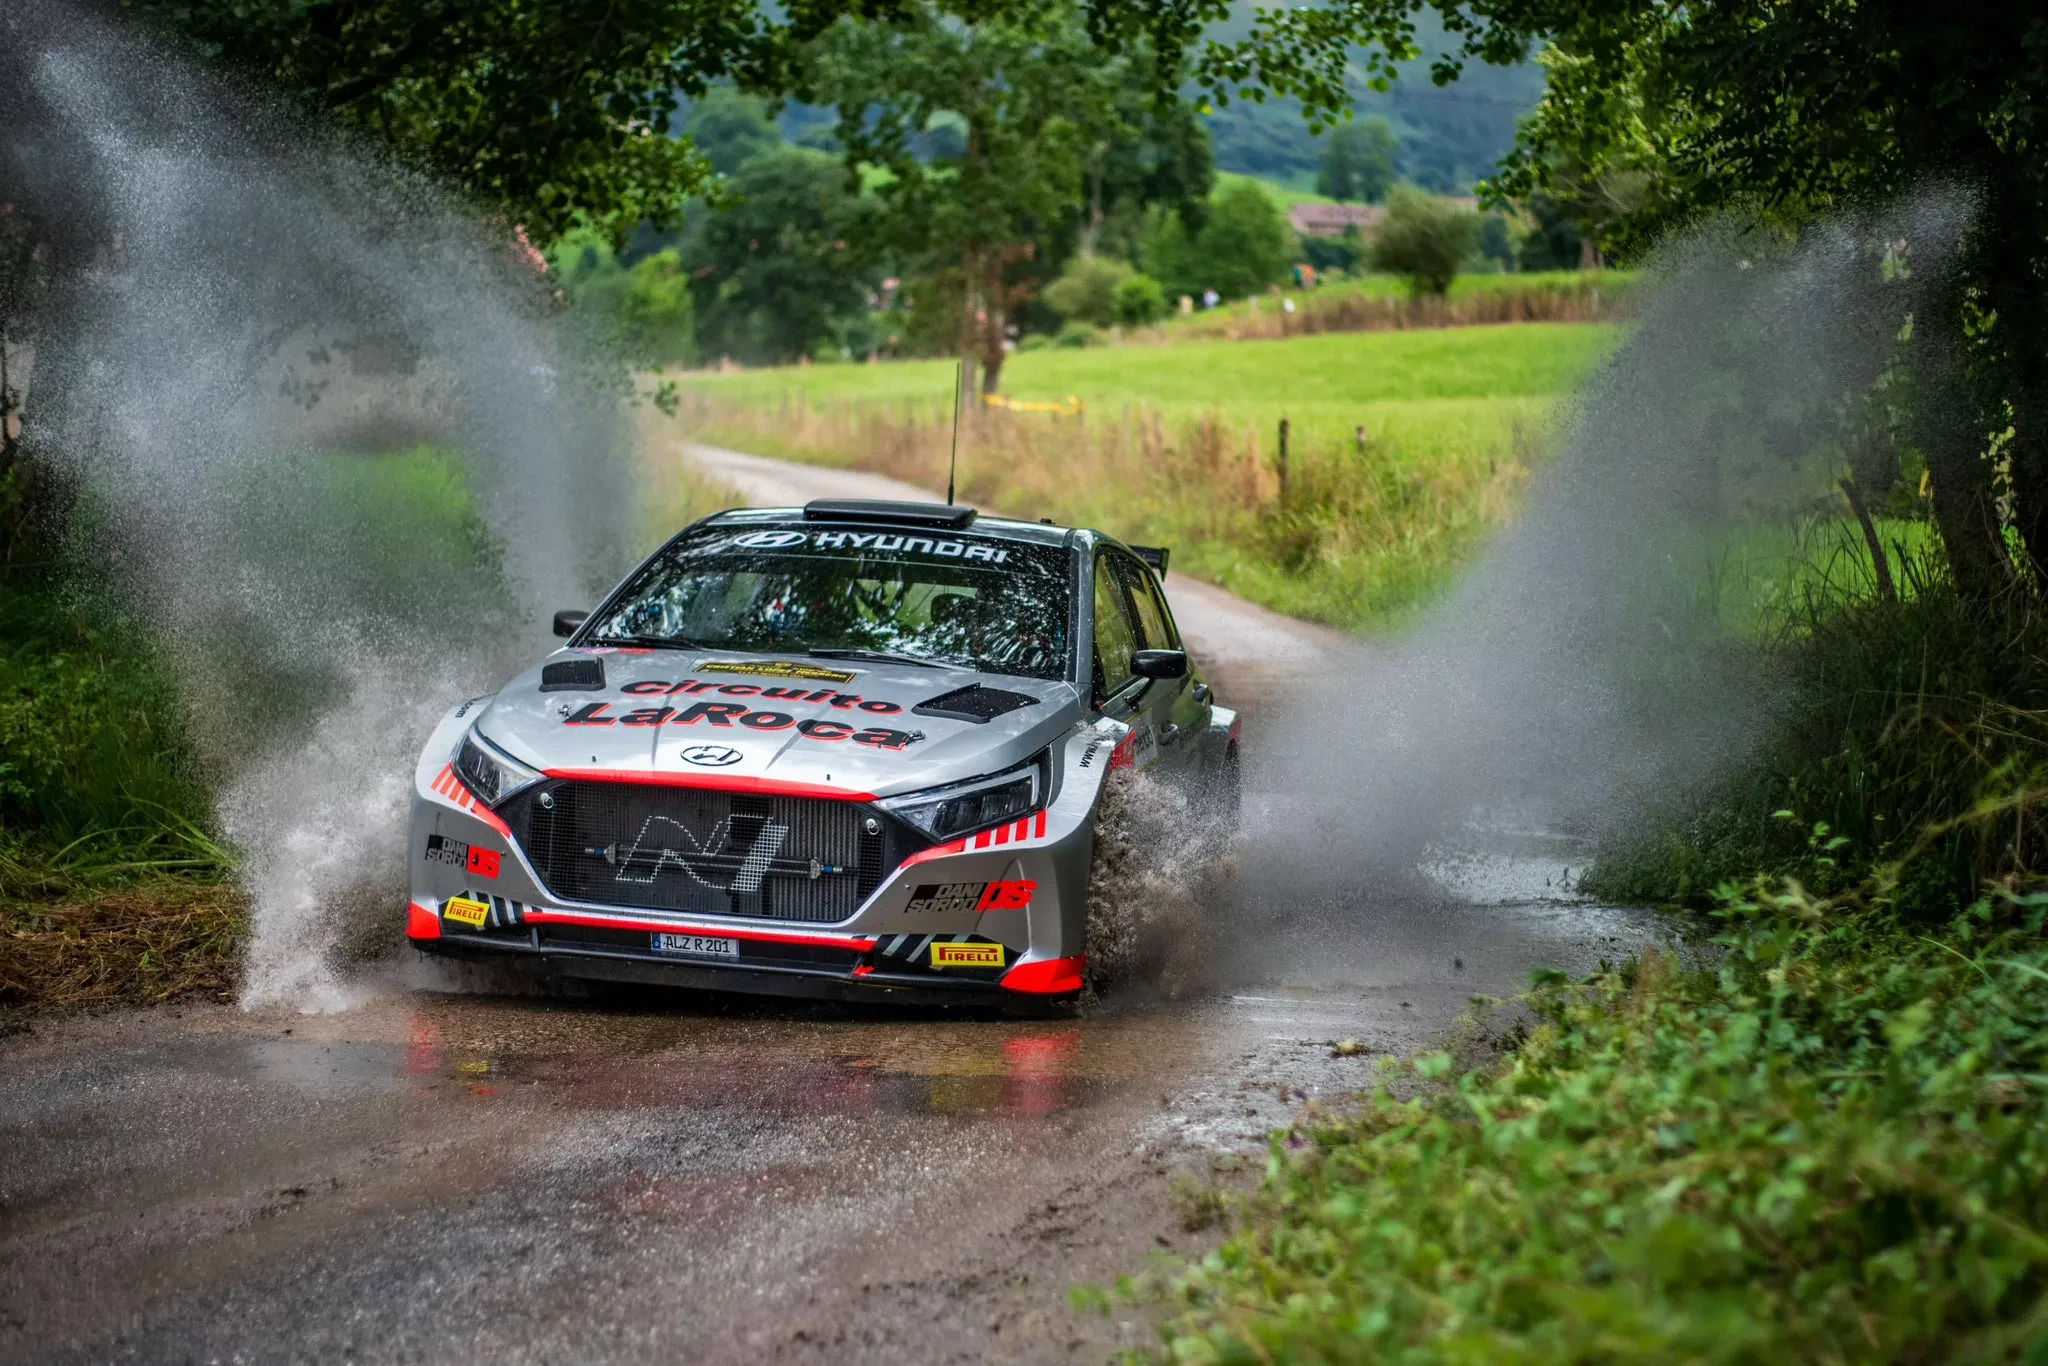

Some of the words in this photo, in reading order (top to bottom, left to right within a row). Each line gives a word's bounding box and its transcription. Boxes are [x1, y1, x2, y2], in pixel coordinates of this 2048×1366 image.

[814, 532, 1009, 563] HYUNDAI
[934, 883, 981, 898] DANI
[449, 902, 484, 922] PIRELLI
[906, 898, 977, 913] SORDO
[665, 935, 691, 950] ALZ
[694, 938, 704, 951] R
[705, 939, 730, 953] 201
[938, 946, 999, 962] PIRELLI
